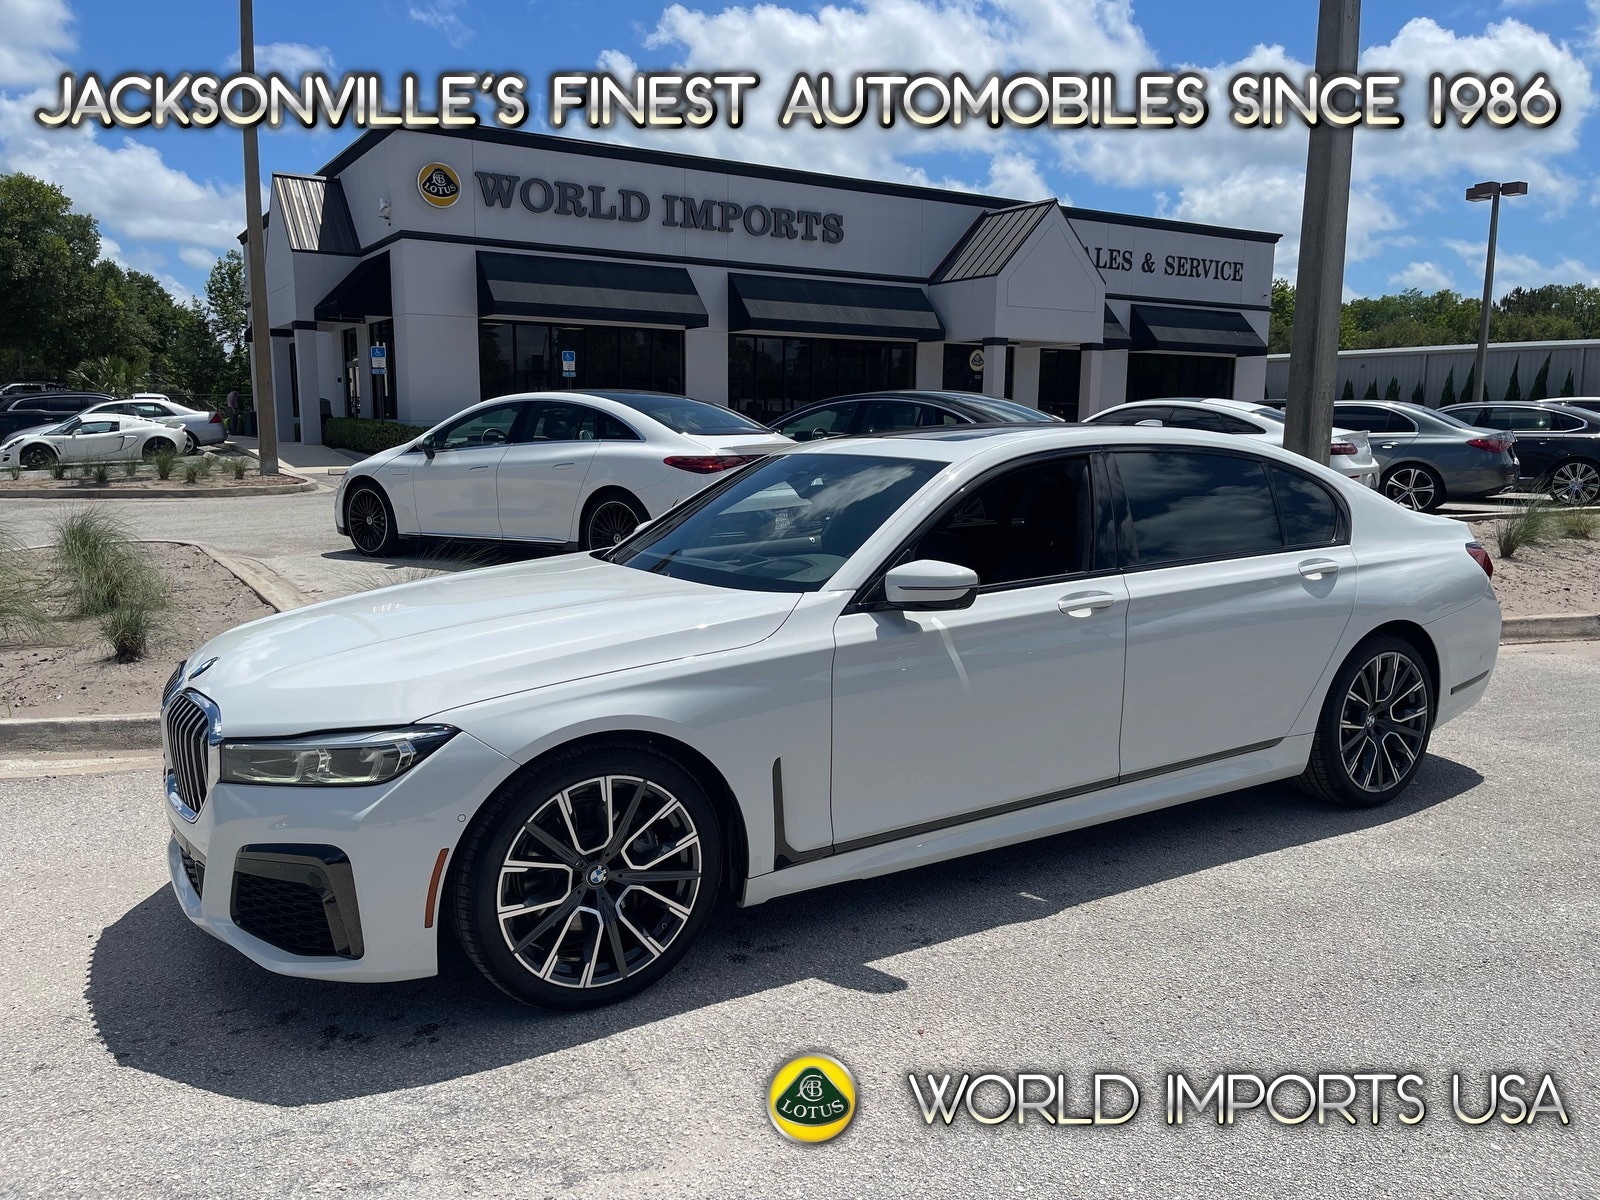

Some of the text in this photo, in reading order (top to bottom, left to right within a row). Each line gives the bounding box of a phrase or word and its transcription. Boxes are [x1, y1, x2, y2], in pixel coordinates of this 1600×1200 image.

[424, 181, 457, 195] LOTUS
[475, 171, 845, 244] WORLD IMPORTS
[1141, 252, 1156, 274] &
[1164, 255, 1244, 282] SERVICE
